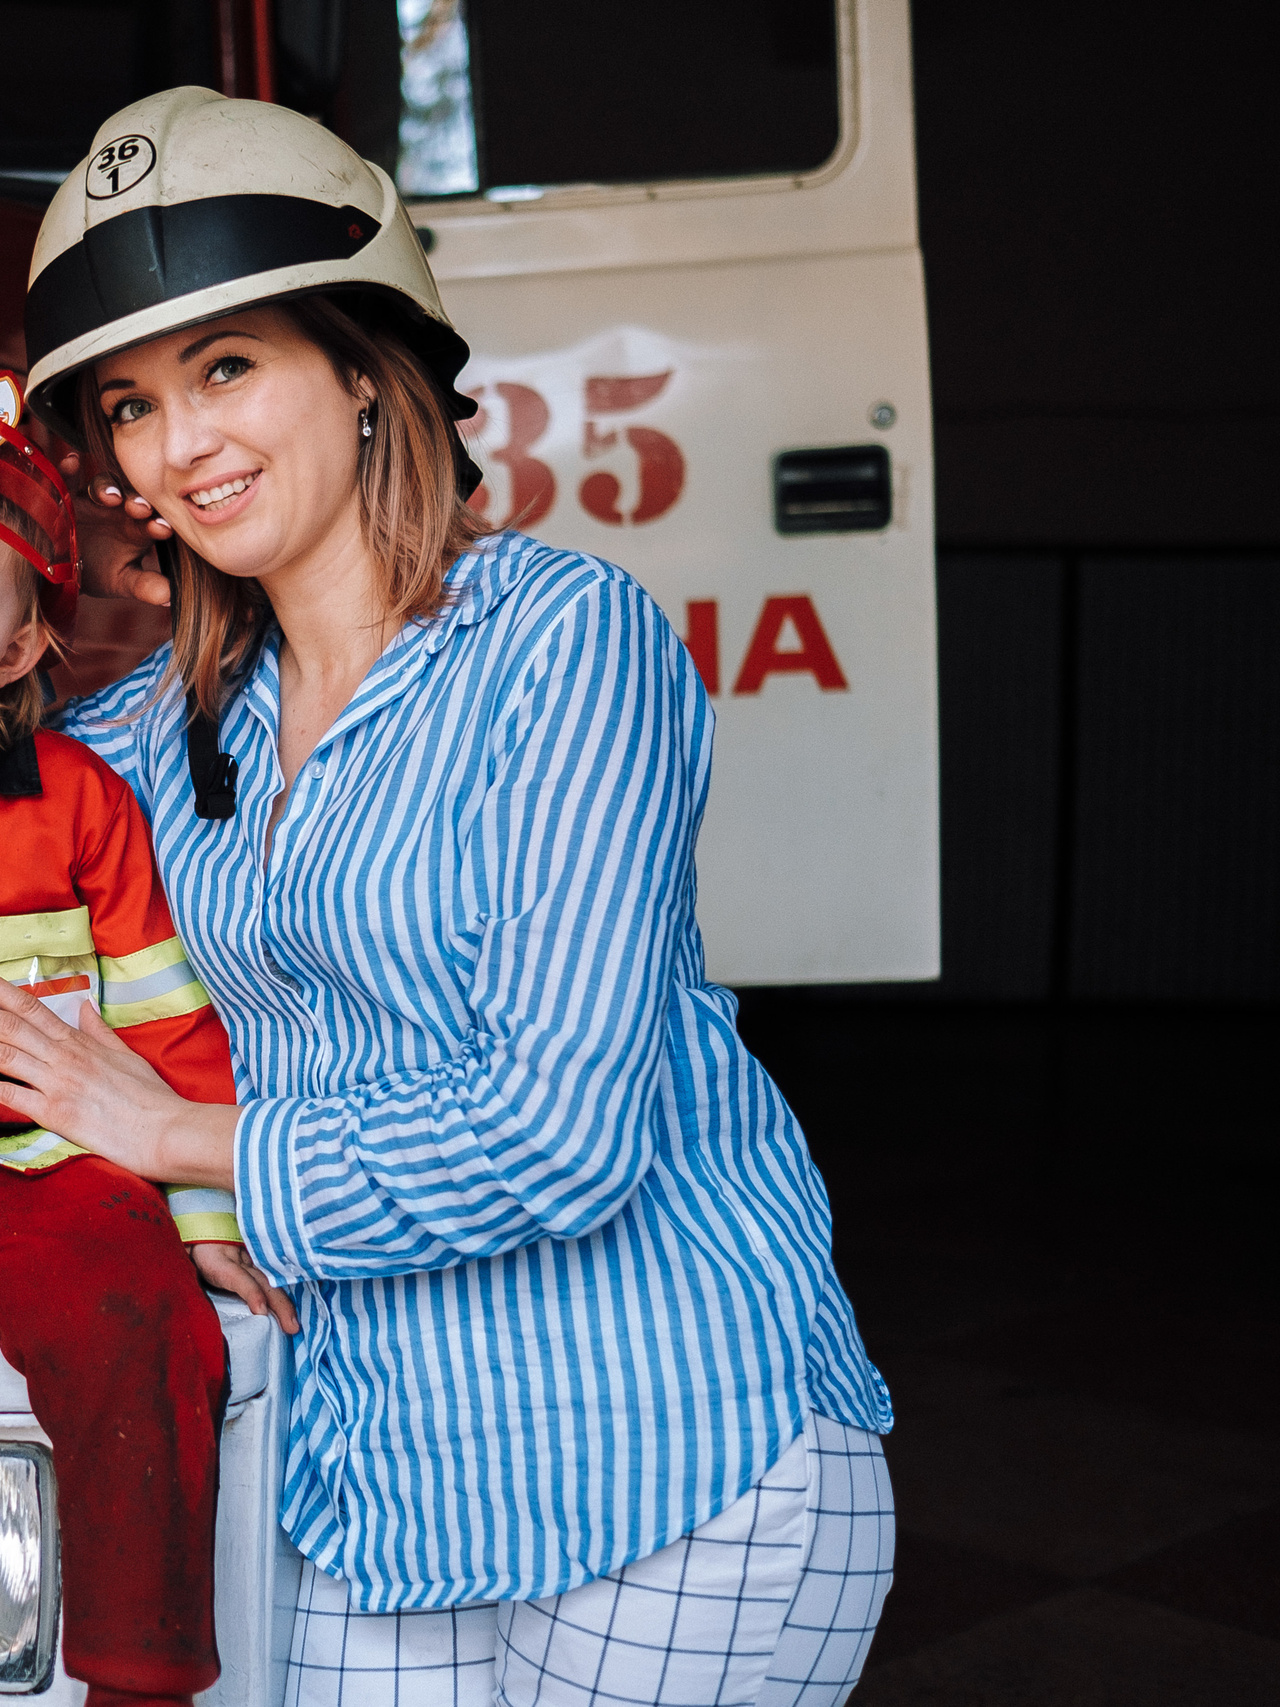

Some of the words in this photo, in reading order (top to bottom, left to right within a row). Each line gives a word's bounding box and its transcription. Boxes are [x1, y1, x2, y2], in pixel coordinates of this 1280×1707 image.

[97, 138, 140, 171] 36
[106, 167, 120, 194] 1
[455, 369, 687, 531] 35
